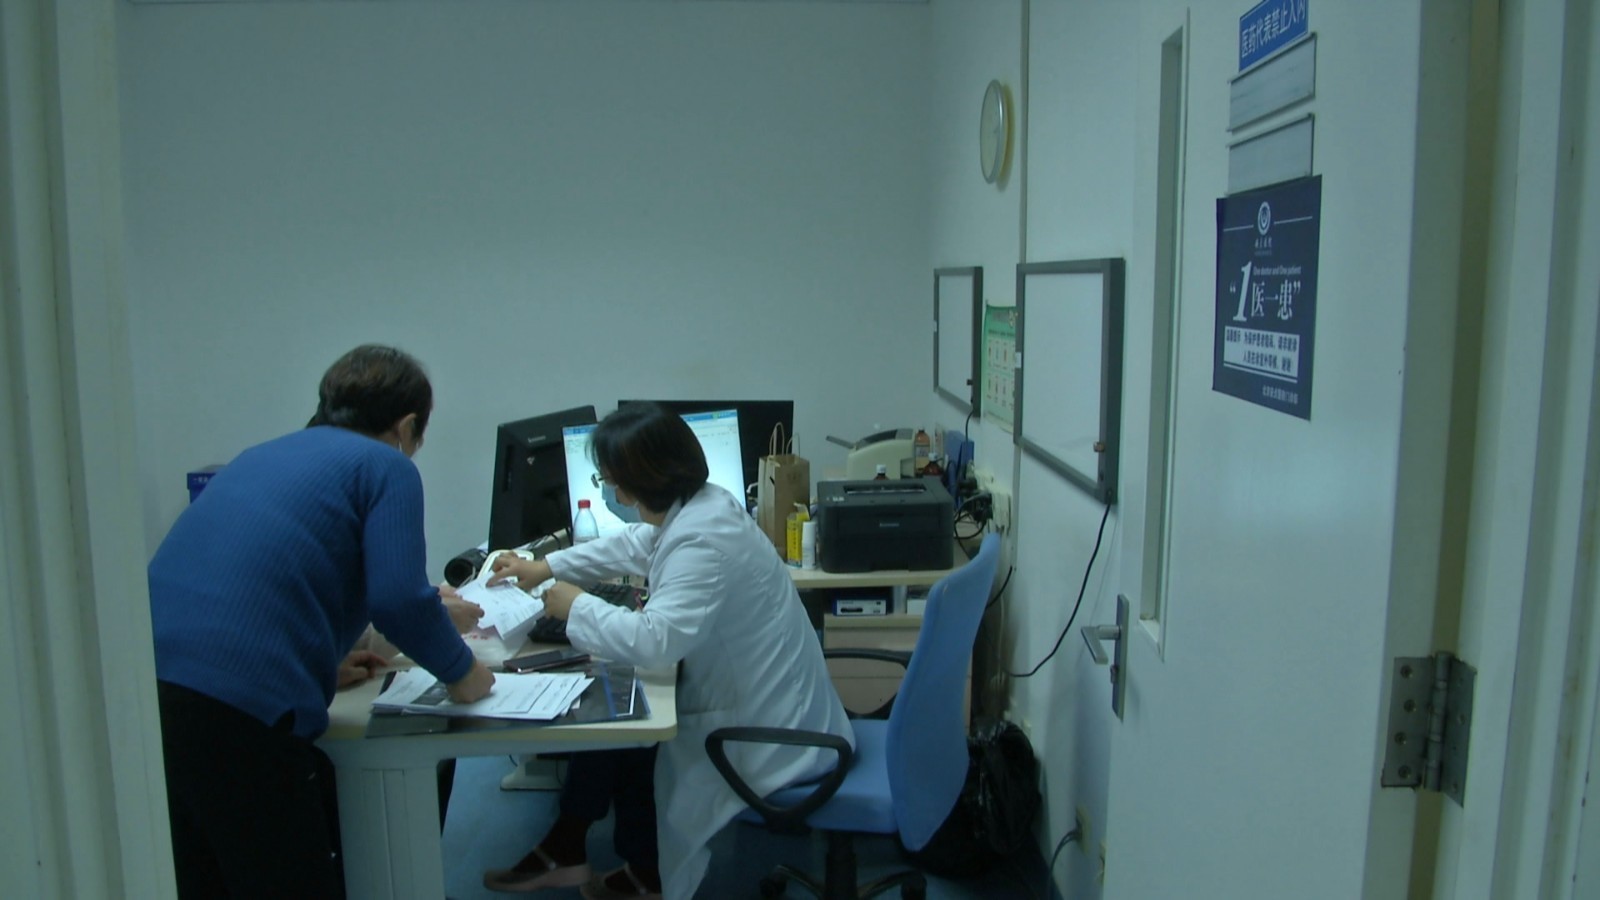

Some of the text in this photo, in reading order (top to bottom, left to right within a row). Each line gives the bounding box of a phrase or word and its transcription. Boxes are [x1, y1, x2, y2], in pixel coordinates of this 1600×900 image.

[1241, 0, 1306, 58] 医药代表禁止入内
